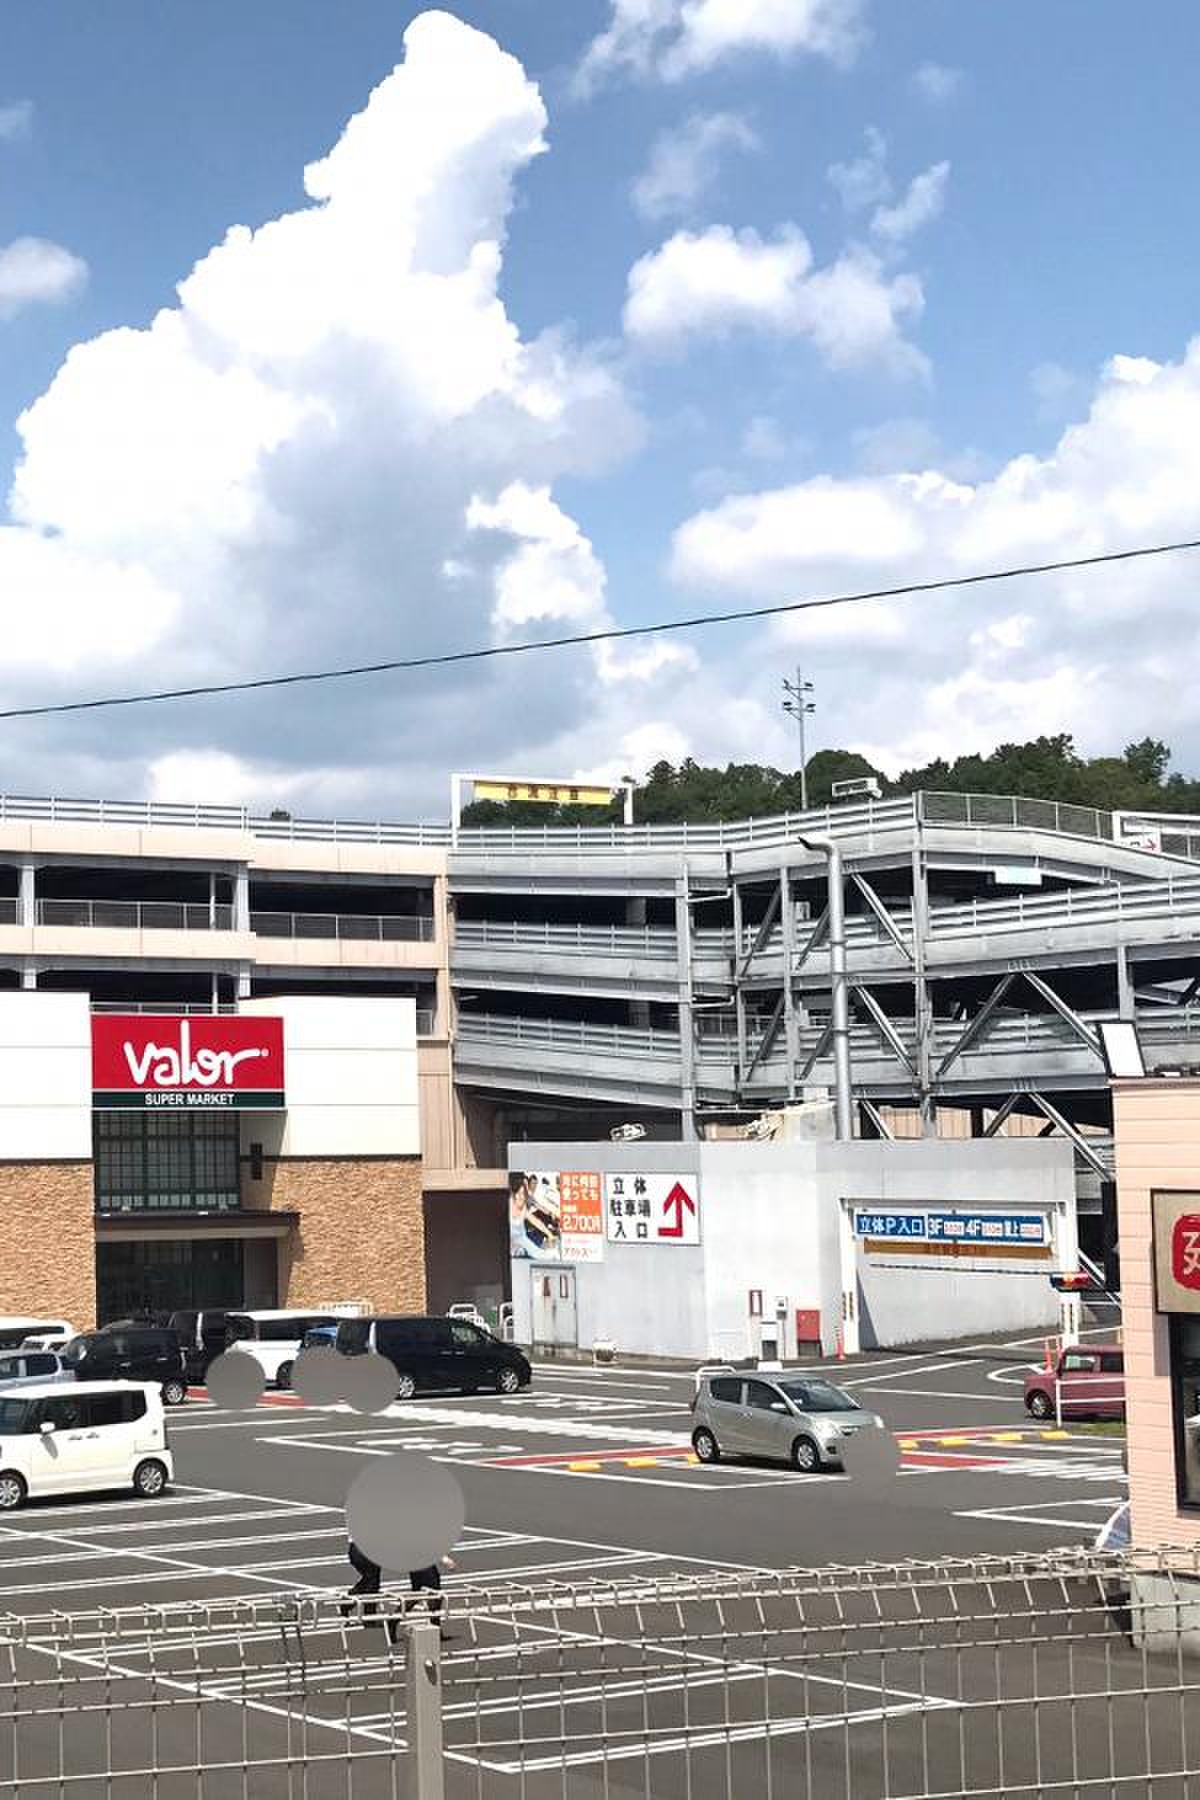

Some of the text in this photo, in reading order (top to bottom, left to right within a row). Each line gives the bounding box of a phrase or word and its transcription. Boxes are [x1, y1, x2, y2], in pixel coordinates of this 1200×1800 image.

[145, 1093, 234, 1106] SUPER MARKET
[612, 1176, 647, 1196] 立体
[610, 1199, 651, 1217] 駐車場
[614, 1220, 648, 1239] 入口
[858, 1216, 923, 1234] 立体P入口
